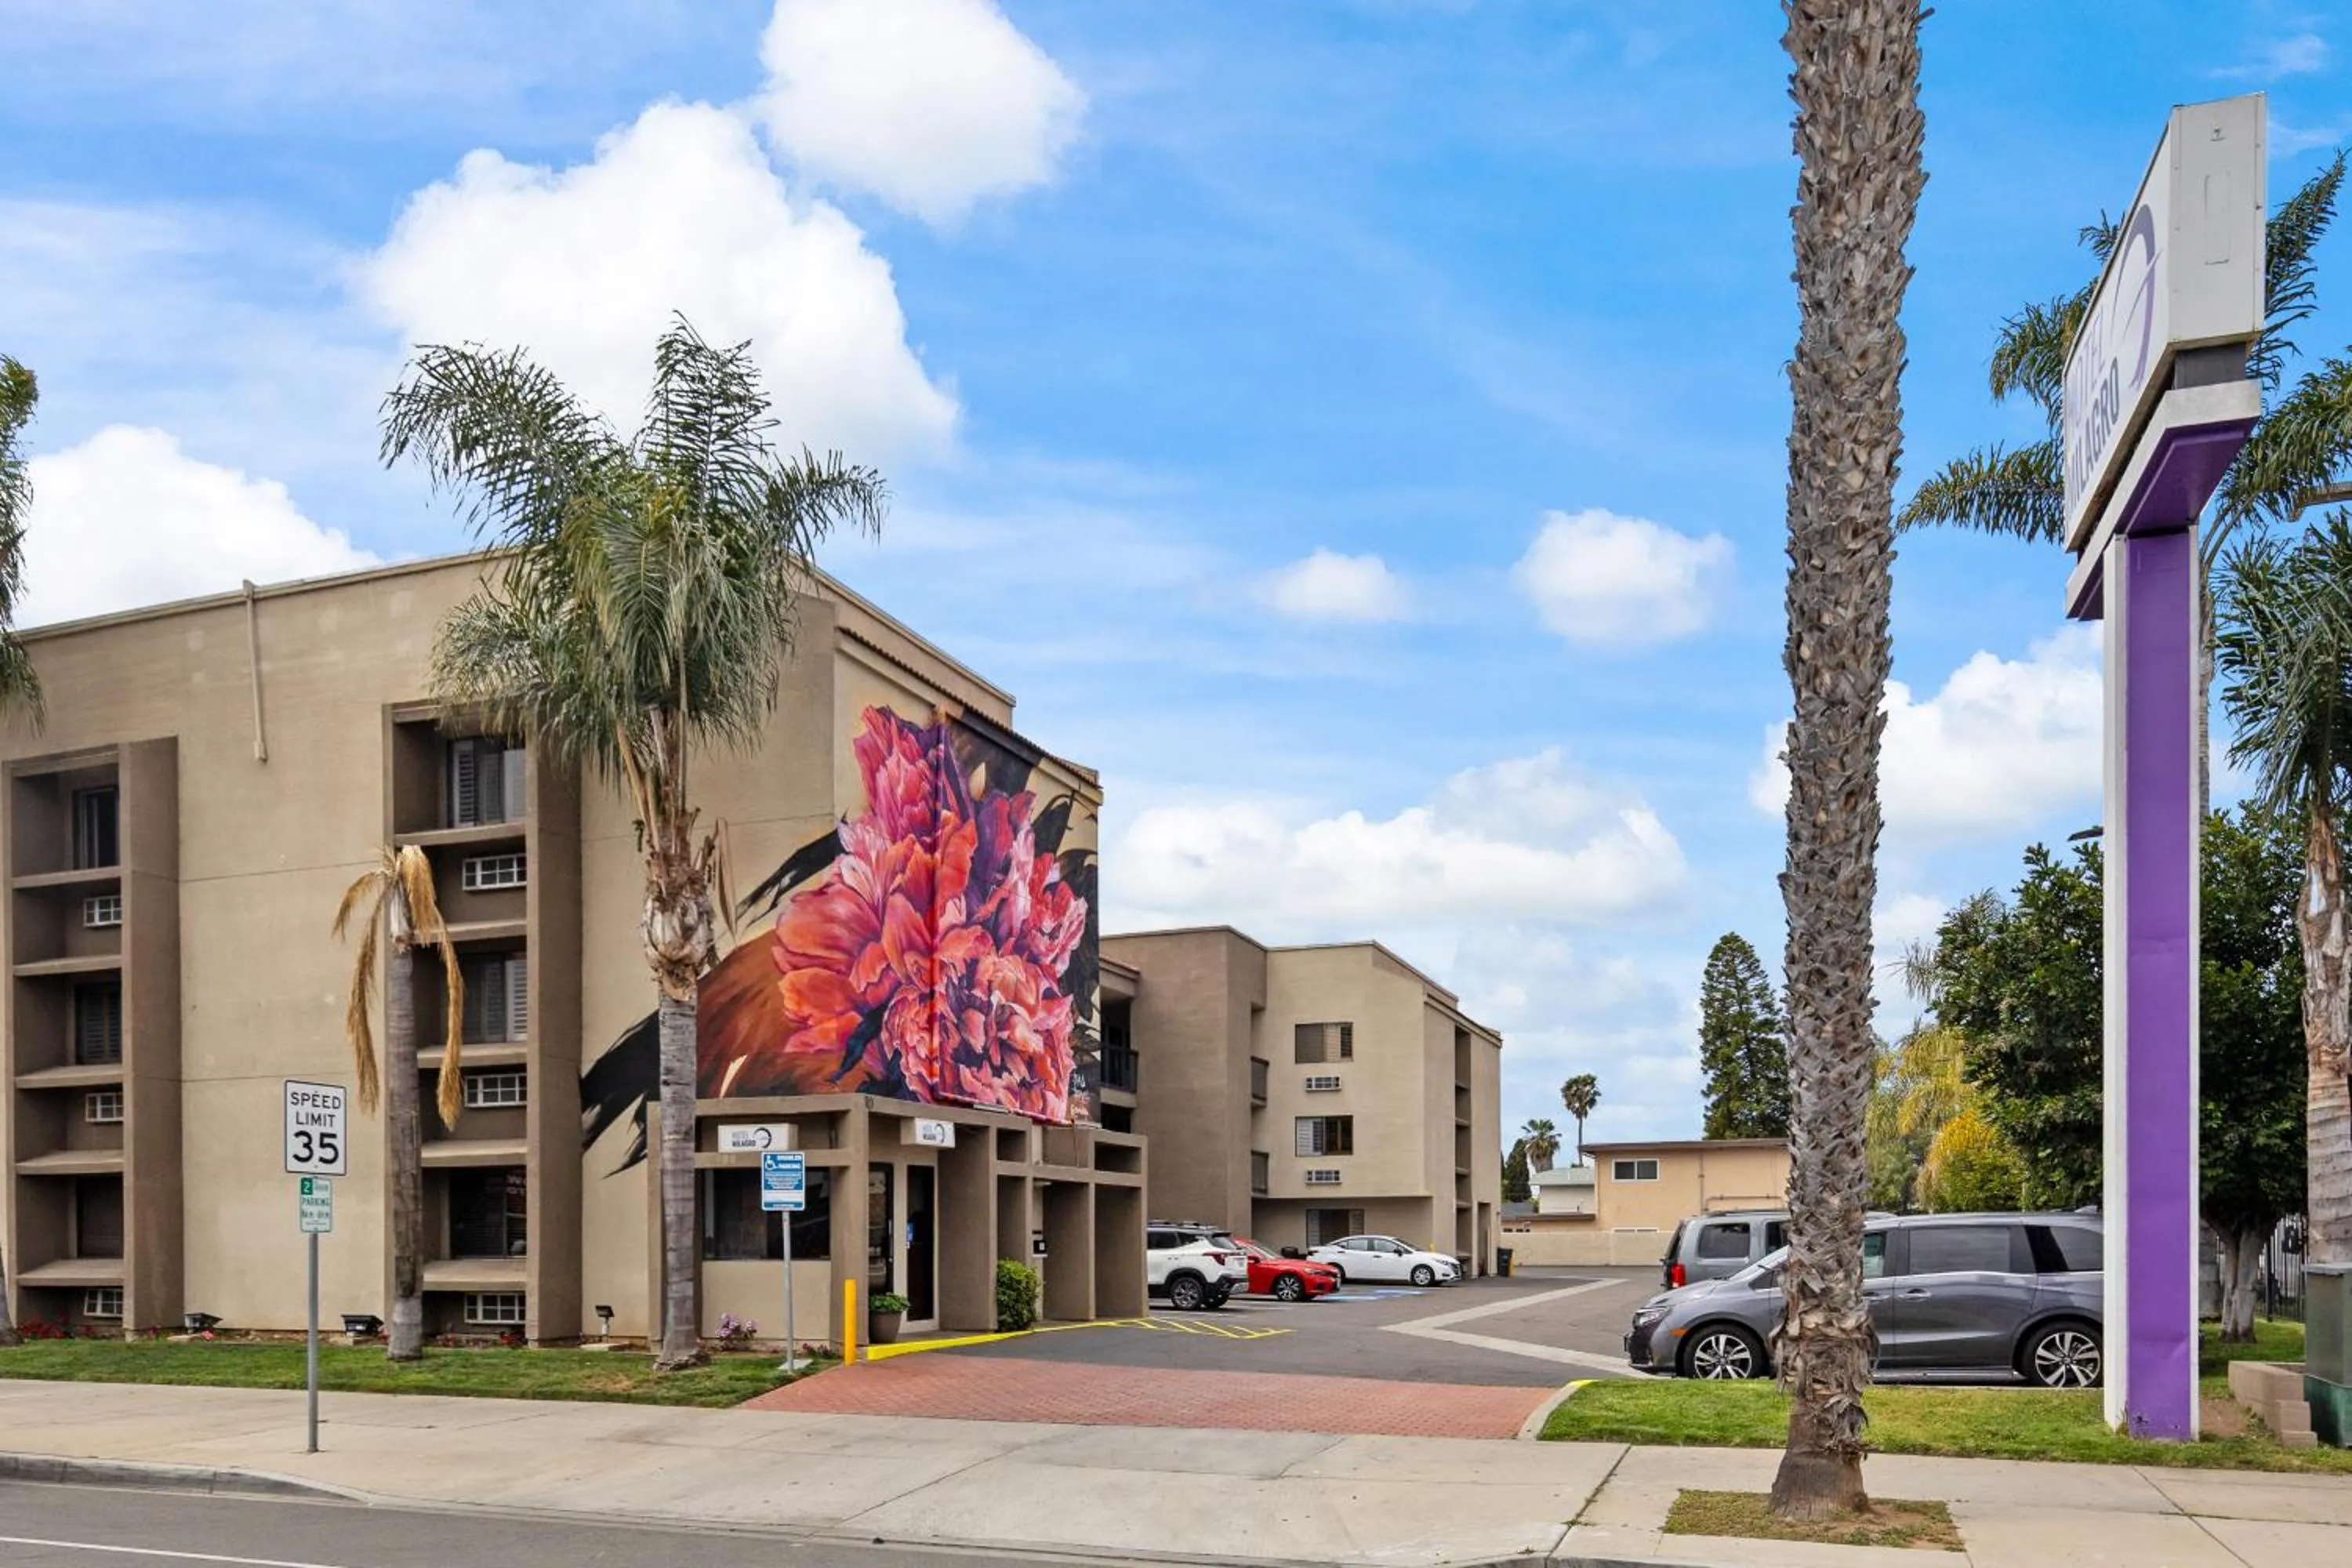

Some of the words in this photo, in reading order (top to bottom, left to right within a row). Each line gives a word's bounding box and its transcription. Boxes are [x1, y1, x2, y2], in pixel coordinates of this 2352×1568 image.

[2068, 357, 2119, 514] MILAGRO
[291, 1091, 341, 1109] SPEED
[296, 1111, 336, 1127] LIMIT
[292, 1130, 339, 1164] 35
[303, 1181, 311, 1192] 2
